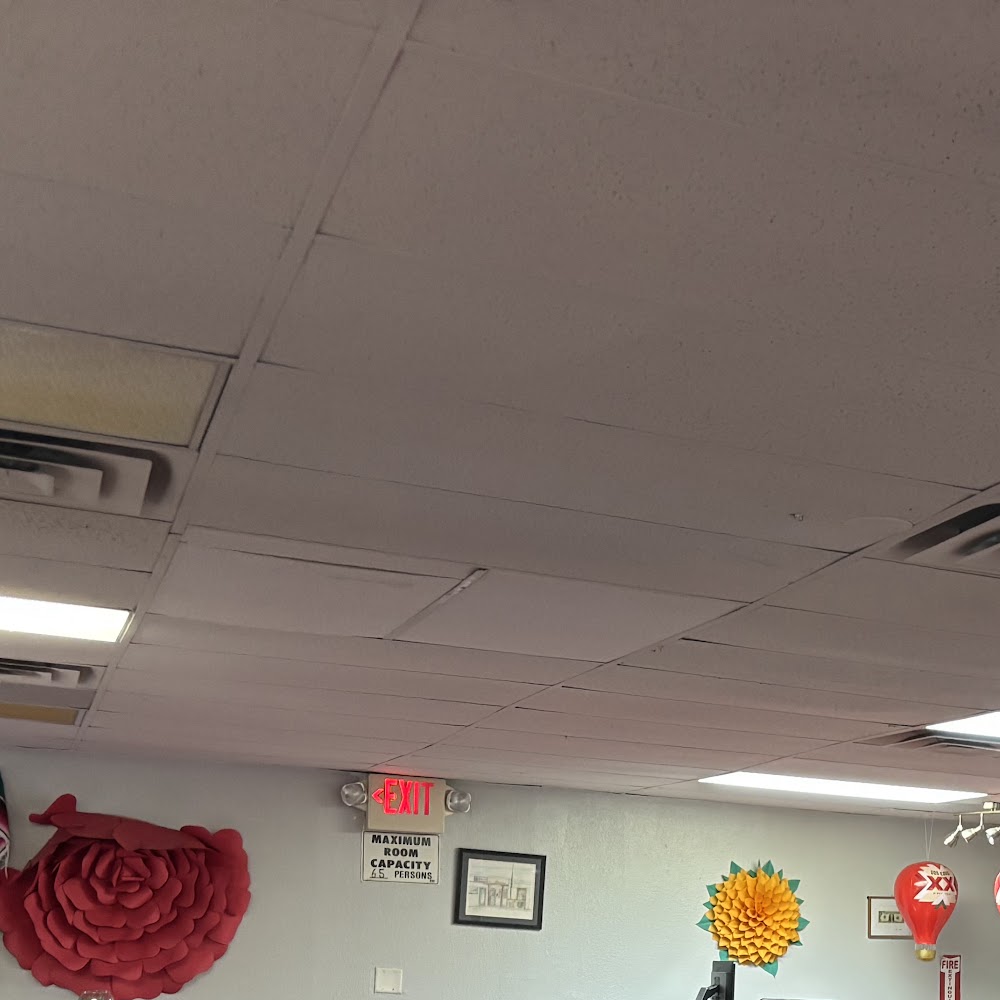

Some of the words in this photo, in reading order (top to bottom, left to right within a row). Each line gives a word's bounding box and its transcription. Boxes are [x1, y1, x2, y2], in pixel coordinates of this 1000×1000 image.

[384, 778, 434, 815] EXIT
[371, 834, 431, 846] MAXIMUM
[384, 848, 418, 857] ROOM
[370, 859, 431, 870] CAPACITY
[371, 868, 385, 878] 65
[394, 870, 432, 880] PERSONS
[927, 876, 955, 891] XX
[942, 961, 958, 969] FIRE
